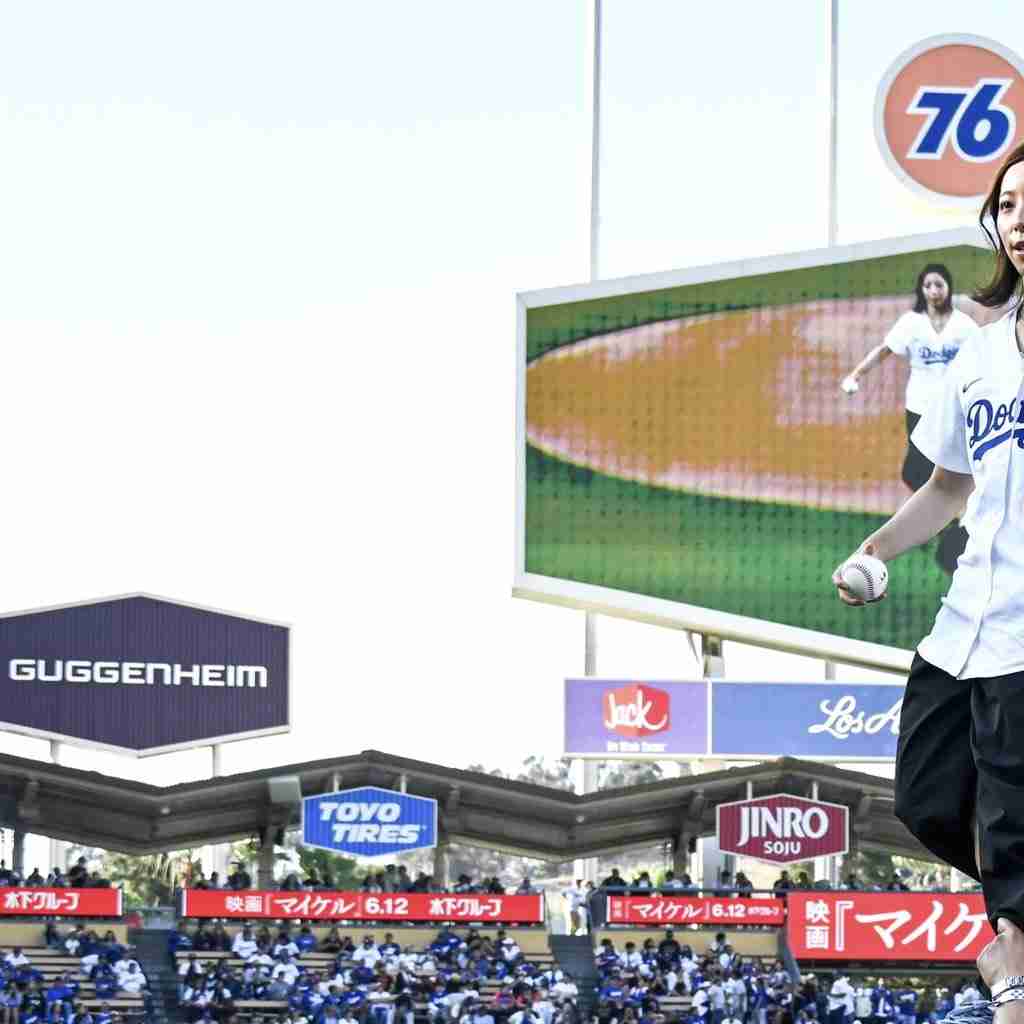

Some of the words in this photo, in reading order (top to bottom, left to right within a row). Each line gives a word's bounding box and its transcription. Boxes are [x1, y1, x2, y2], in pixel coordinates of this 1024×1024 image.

[906, 78, 1016, 162] 76
[9, 659, 268, 687] GUGGENHEIM
[605, 690, 668, 729] Jack
[808, 696, 865, 739] Los
[320, 802, 401, 822] TOYO
[331, 823, 420, 843] TIRES
[737, 806, 829, 847] JINRO
[763, 841, 801, 855] SOJU
[365, 899, 409, 915] 6.12
[711, 903, 746, 918] 6.12
[806, 900, 831, 949] 映画
